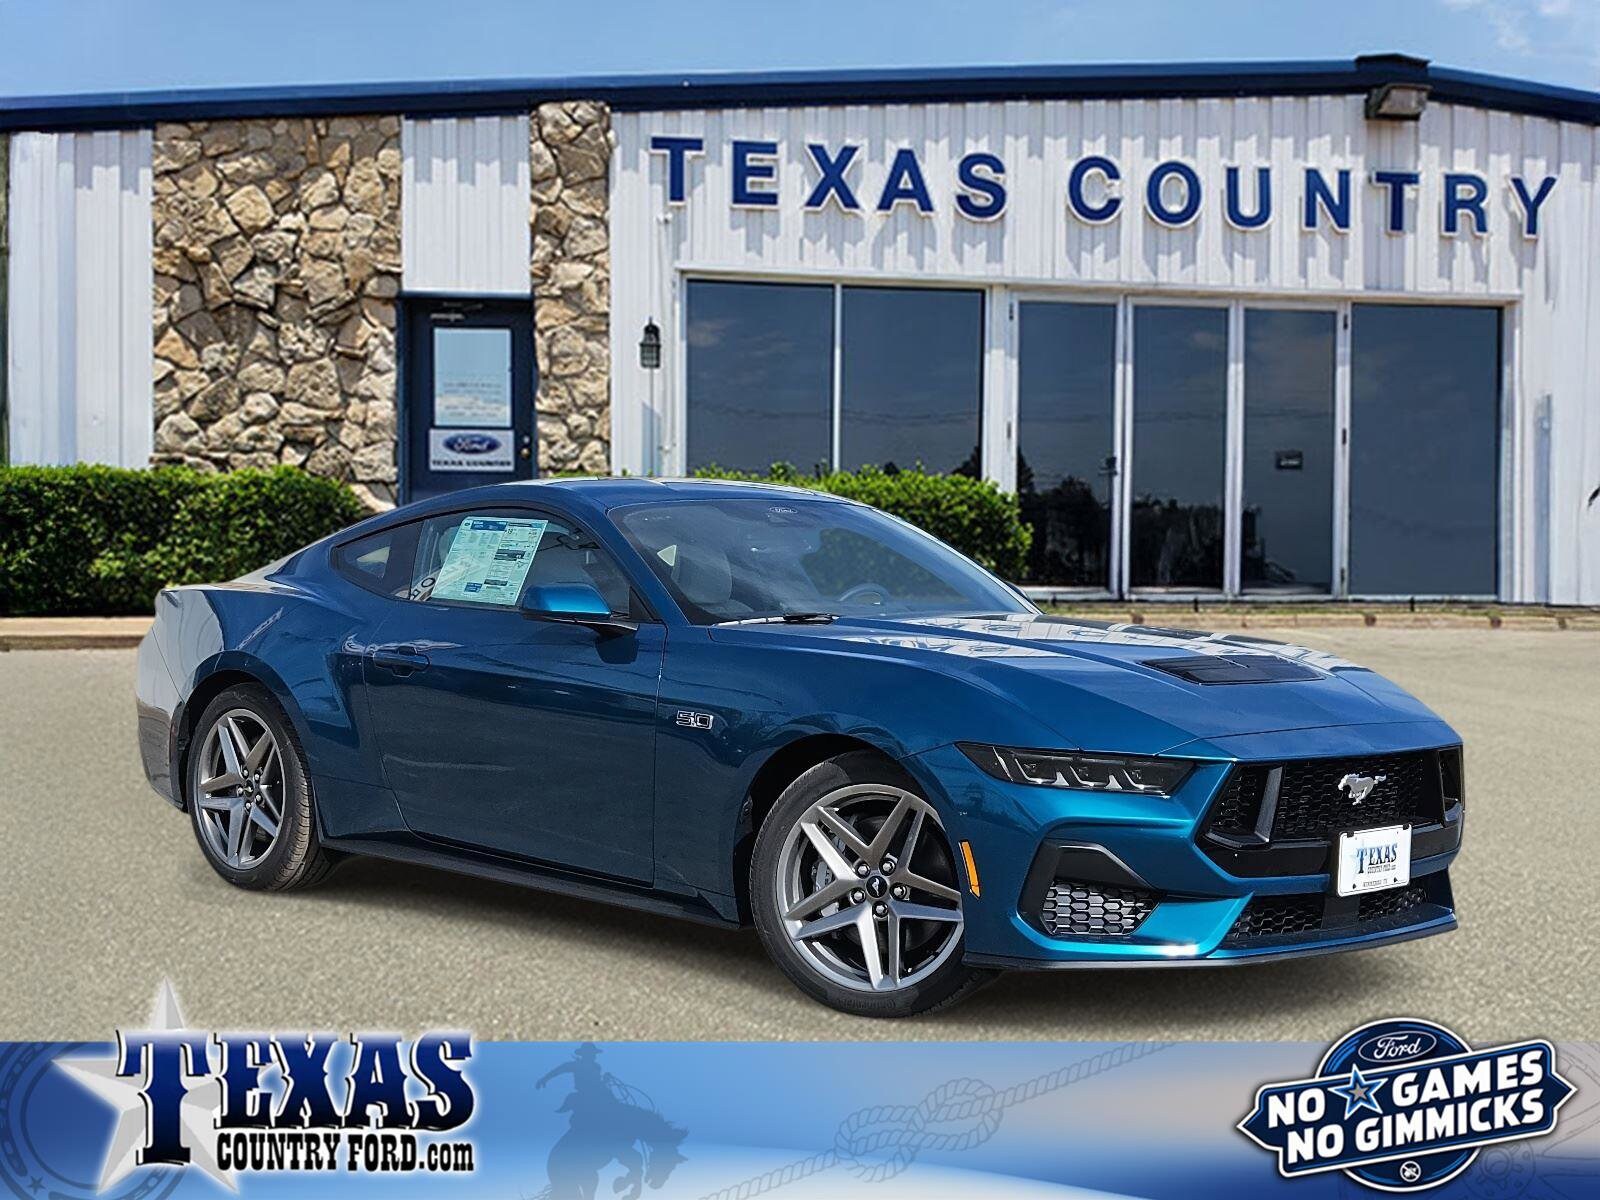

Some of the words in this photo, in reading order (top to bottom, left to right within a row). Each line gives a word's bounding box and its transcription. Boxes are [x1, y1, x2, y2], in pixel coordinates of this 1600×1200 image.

[650, 136, 1009, 221] TEXAS
[1066, 156, 1558, 238] COUNTRY
[1356, 843, 1397, 874] TEXAS
